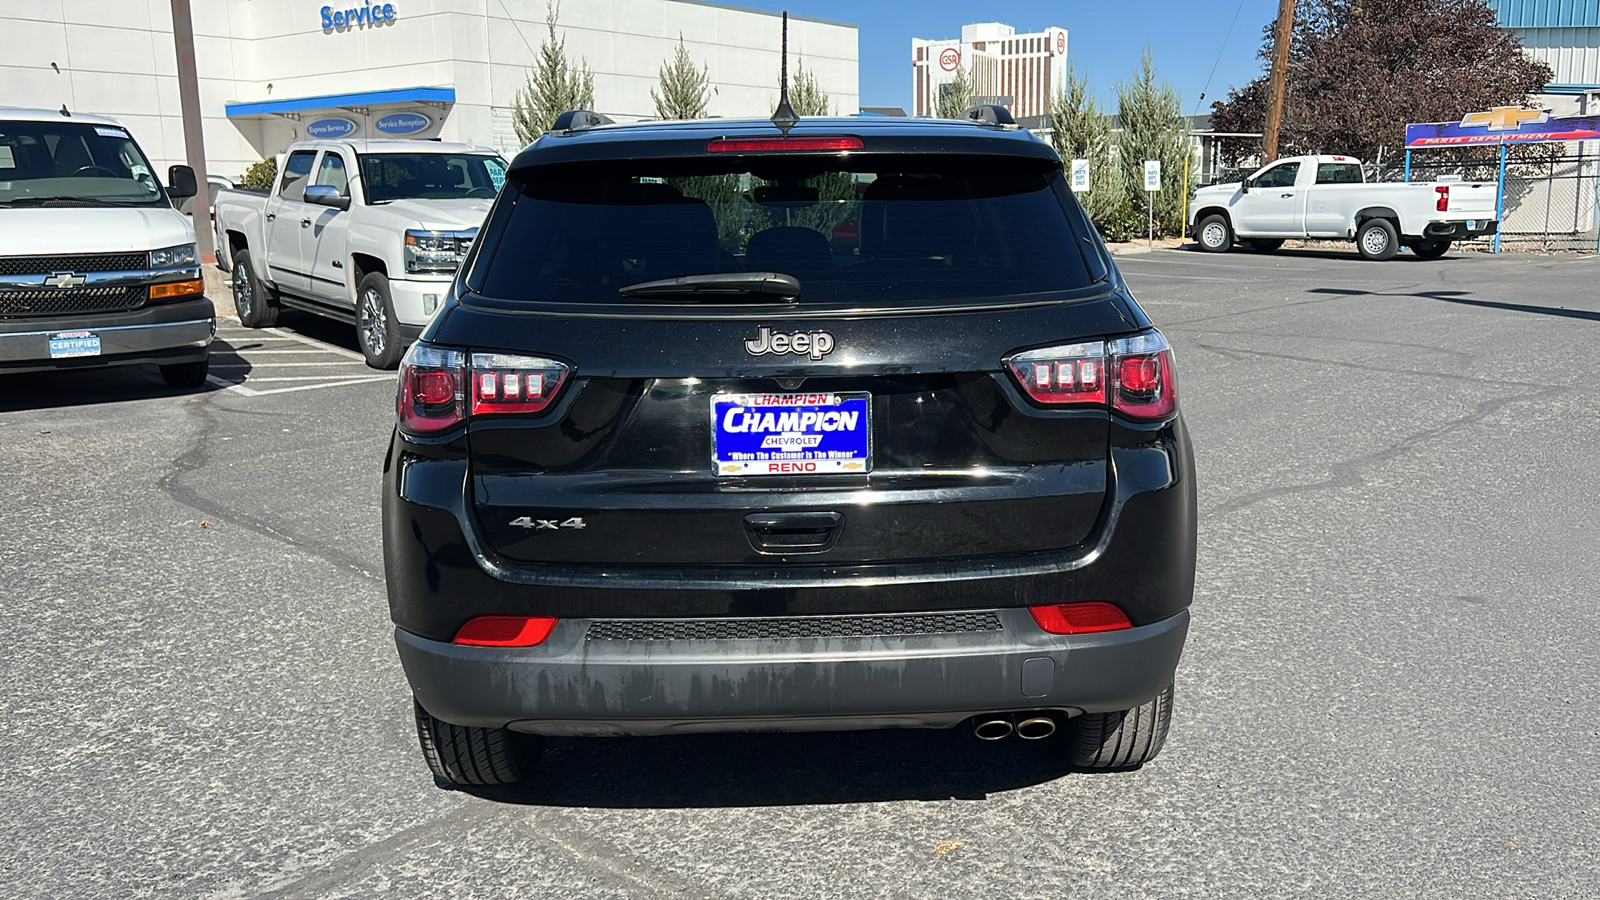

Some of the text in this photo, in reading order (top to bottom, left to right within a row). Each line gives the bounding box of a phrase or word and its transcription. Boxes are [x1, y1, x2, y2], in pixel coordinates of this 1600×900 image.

[320, 0, 394, 28] Service
[379, 118, 426, 128] Service Reception
[309, 124, 345, 134] Express Service
[1470, 133, 1555, 142] DEPARTMENT
[51, 340, 99, 349] CERTIFIED
[744, 326, 834, 360] Jeep
[754, 394, 828, 406] CHAMPION
[723, 407, 859, 433] CHAMPION
[765, 437, 818, 446] CHEVROLET
[756, 452, 769, 460] The
[771, 452, 804, 460] Customer
[814, 451, 827, 459] The
[768, 462, 817, 472] RENO
[508, 516, 587, 530] 4x4
